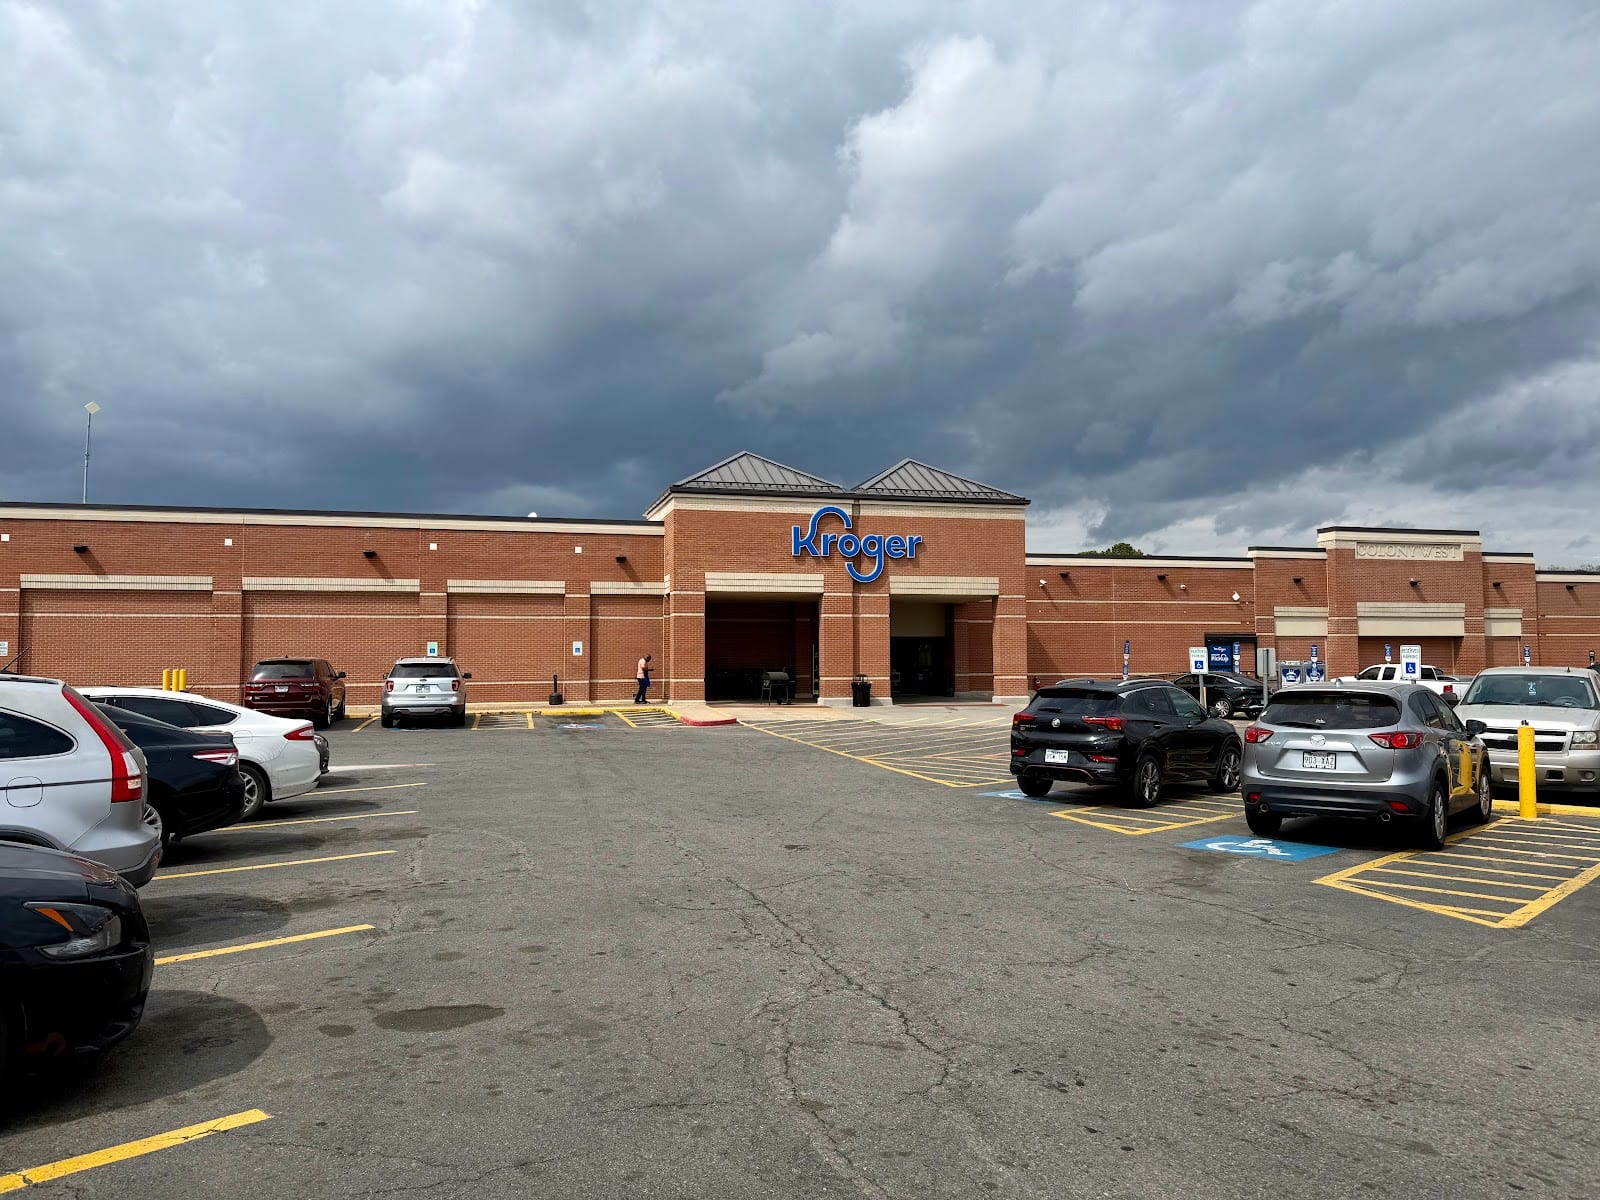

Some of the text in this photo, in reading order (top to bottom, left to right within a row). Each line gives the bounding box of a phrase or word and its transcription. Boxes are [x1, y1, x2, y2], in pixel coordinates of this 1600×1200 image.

[791, 505, 923, 583] Kroger
[1357, 544, 1459, 559] COLONY WEST
